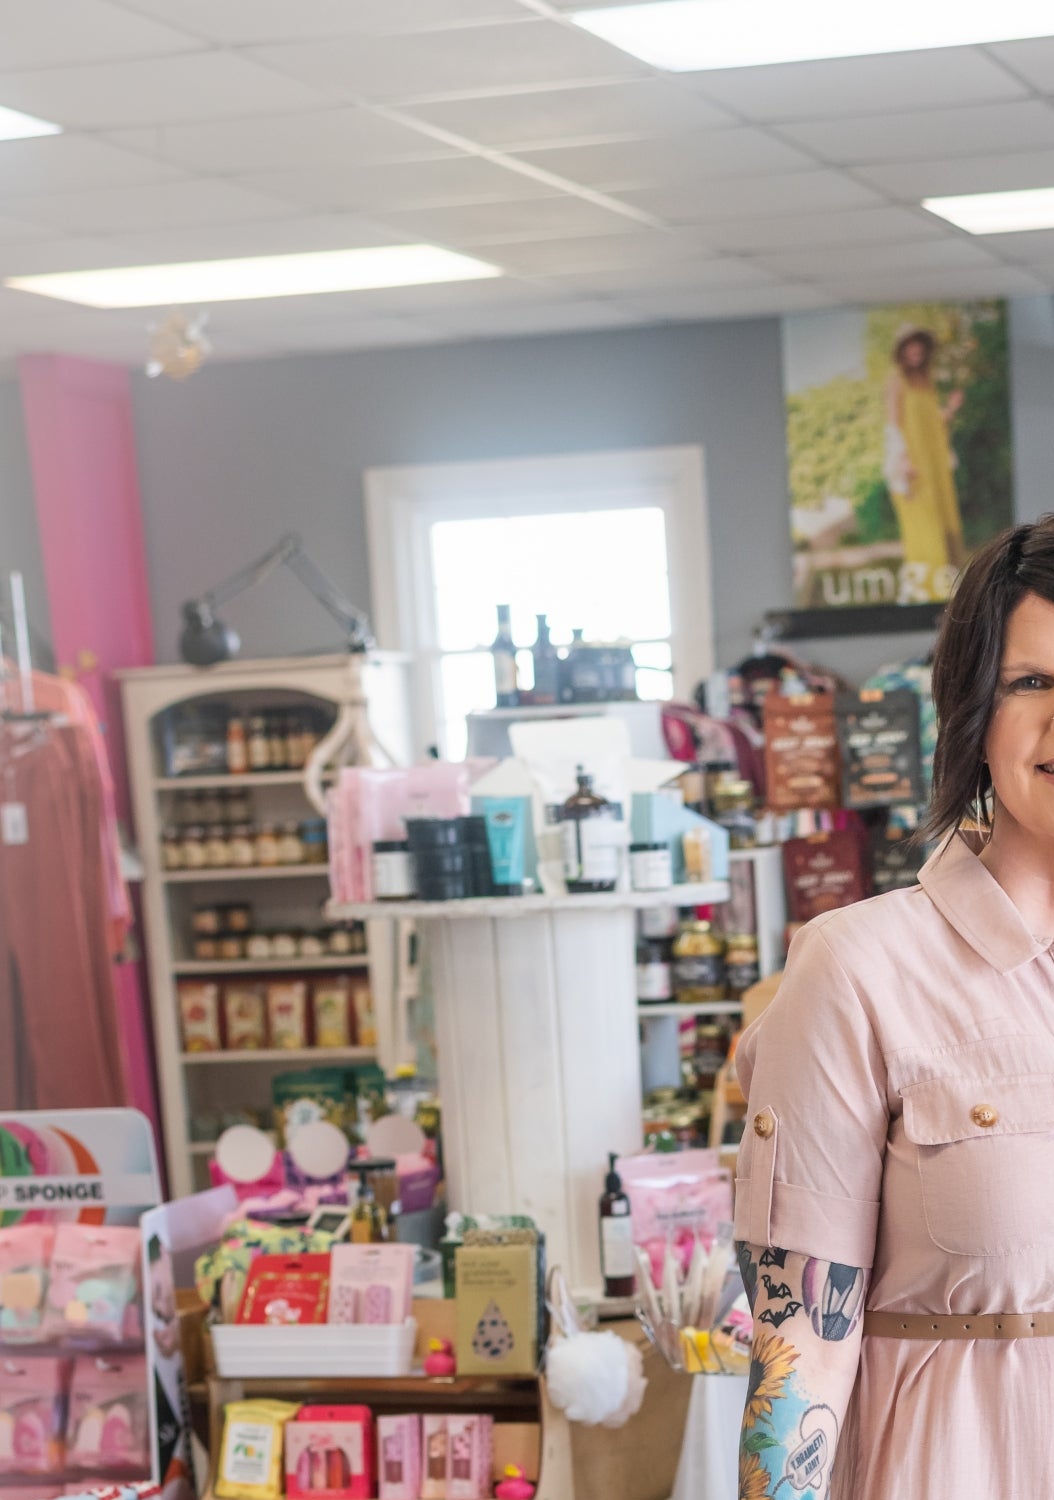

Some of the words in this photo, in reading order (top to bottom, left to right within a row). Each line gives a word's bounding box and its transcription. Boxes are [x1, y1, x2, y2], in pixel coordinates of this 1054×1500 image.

[821, 560, 962, 607] umge
[14, 1182, 104, 1202] SPONGE
[790, 1433, 824, 1471] T.BRAMLETT
[804, 1454, 821, 1477] ARMY
